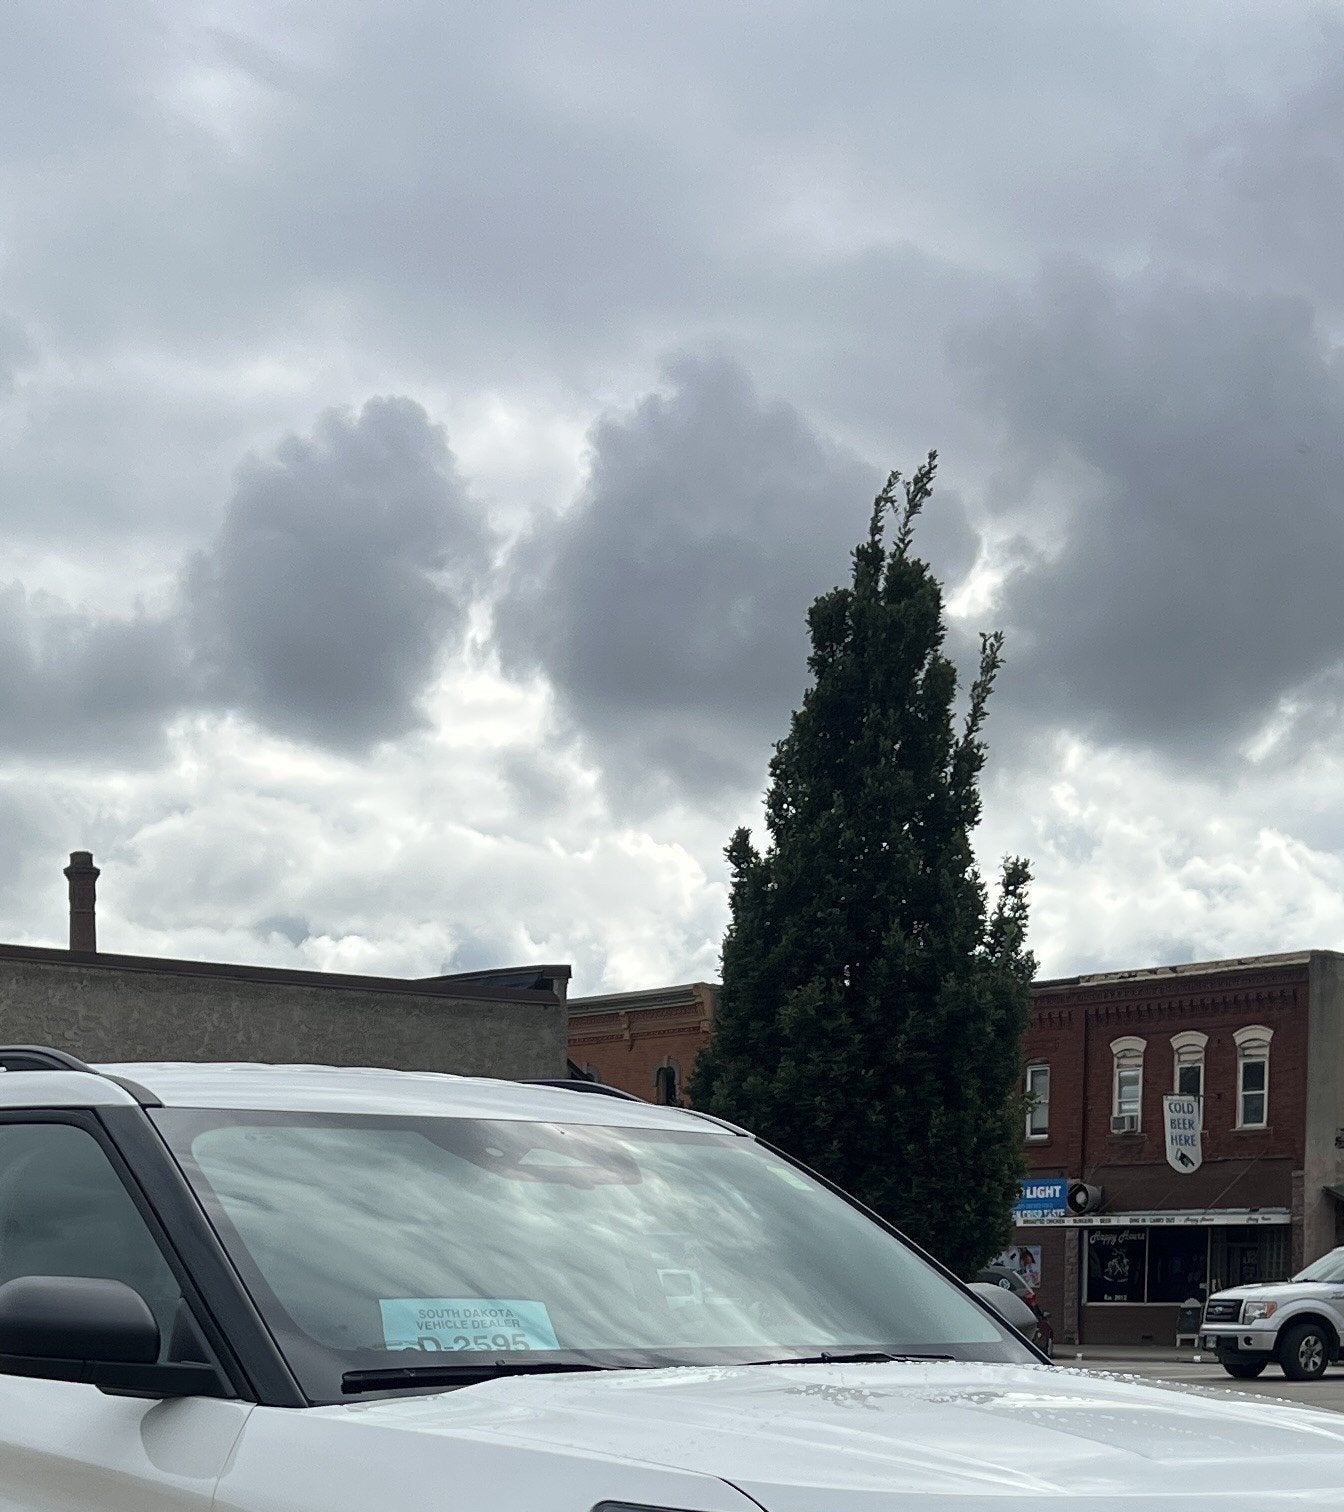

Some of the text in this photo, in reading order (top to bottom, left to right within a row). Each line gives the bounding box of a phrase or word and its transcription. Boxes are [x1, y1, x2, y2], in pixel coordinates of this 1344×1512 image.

[1168, 1102, 1194, 1114] COLD
[1170, 1118, 1195, 1130] BEER
[1170, 1134, 1197, 1147] HERE
[1026, 1185, 1062, 1198] LIGHT
[418, 1308, 514, 1319] SOUTH DAKOTA
[416, 1318, 521, 1330] VEHICLE DEALER
